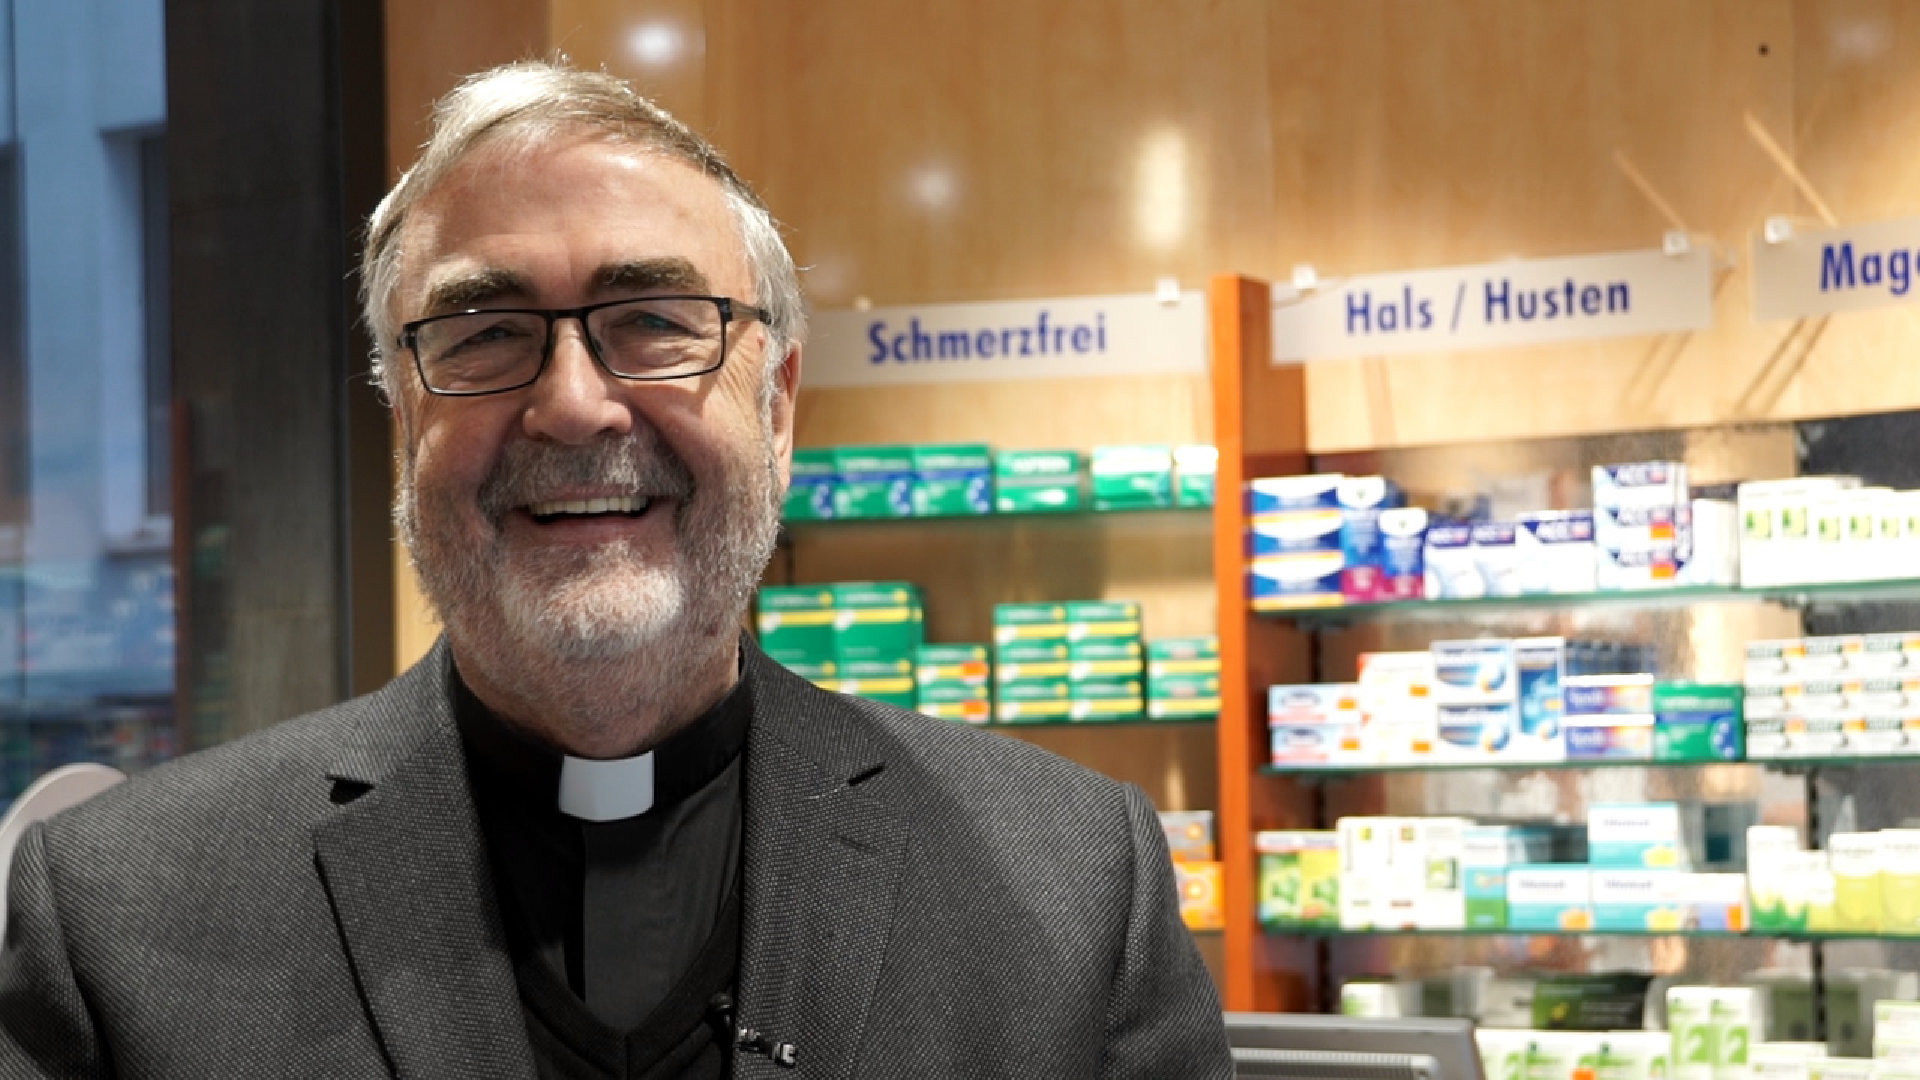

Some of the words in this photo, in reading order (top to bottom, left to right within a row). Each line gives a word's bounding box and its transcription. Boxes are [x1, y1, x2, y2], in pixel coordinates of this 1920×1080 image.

[1346, 287, 1434, 335] Hals
[1450, 281, 1467, 333] /
[1484, 279, 1631, 324] Husten
[868, 311, 1108, 366] Schmerzfrei
